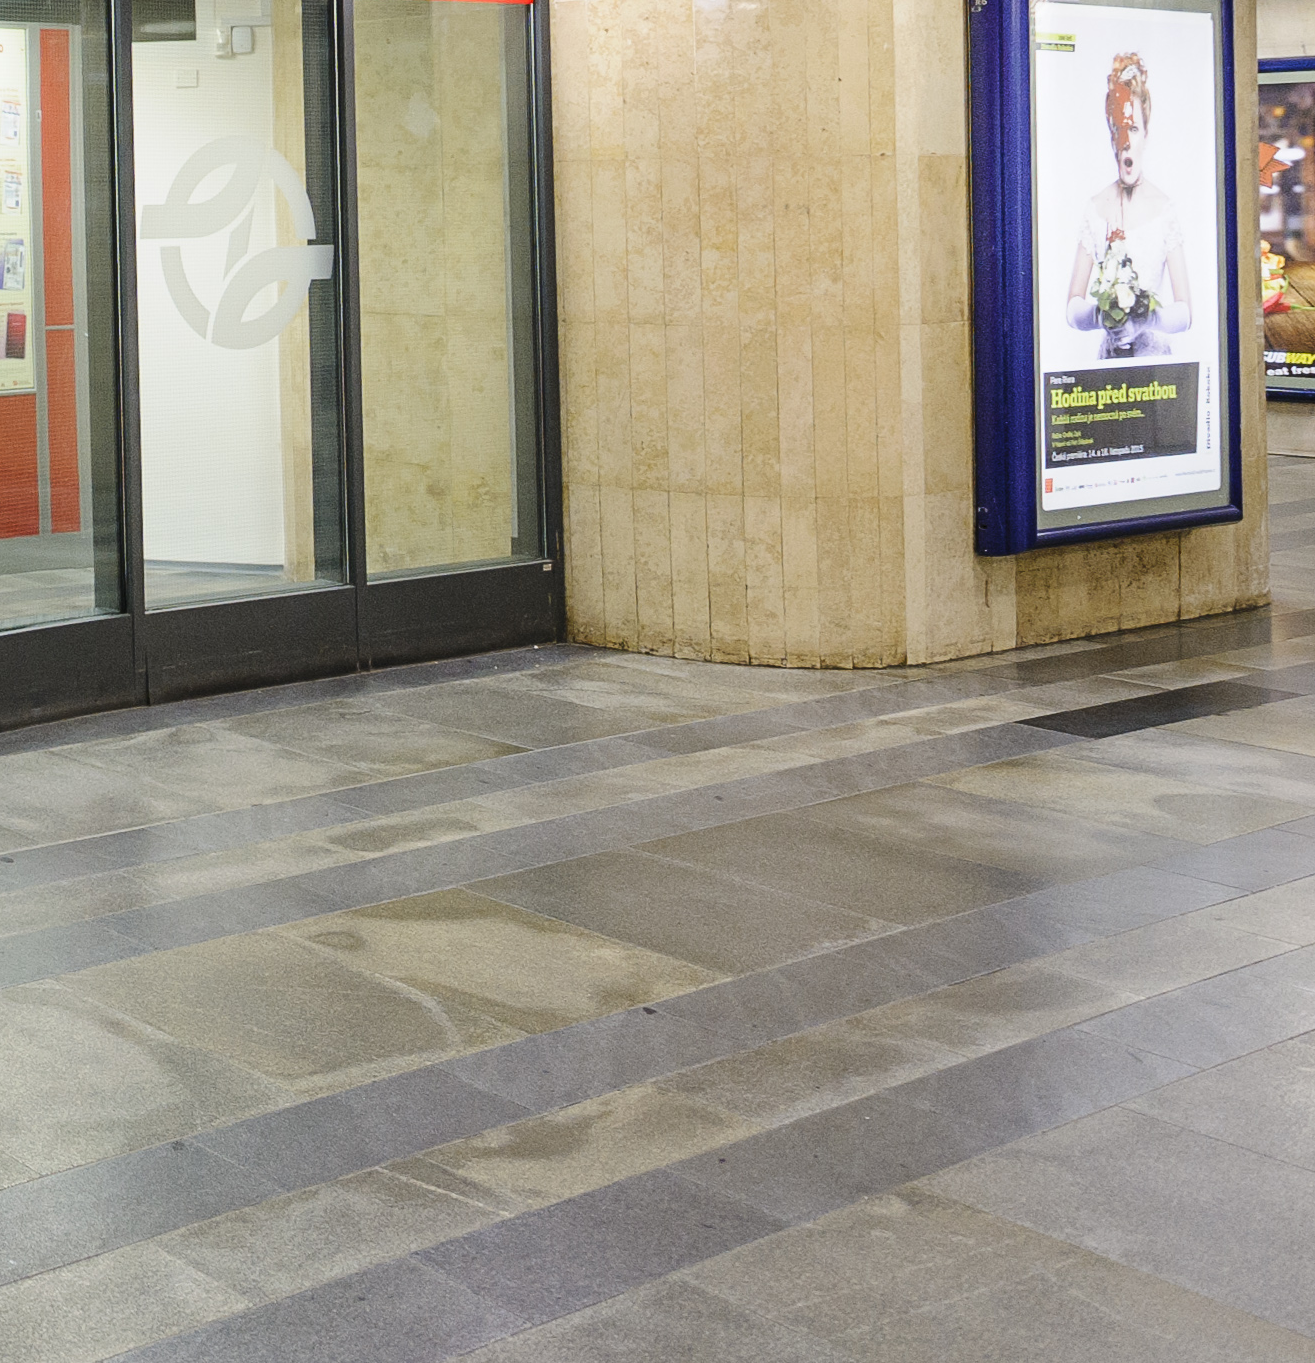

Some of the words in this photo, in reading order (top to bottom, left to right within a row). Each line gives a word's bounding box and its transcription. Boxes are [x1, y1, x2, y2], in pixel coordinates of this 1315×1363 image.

[1267, 367, 1289, 375] eat
[1050, 386, 1098, 409] Hodina
[1097, 383, 1127, 410] před
[1128, 380, 1178, 403] svatbou
